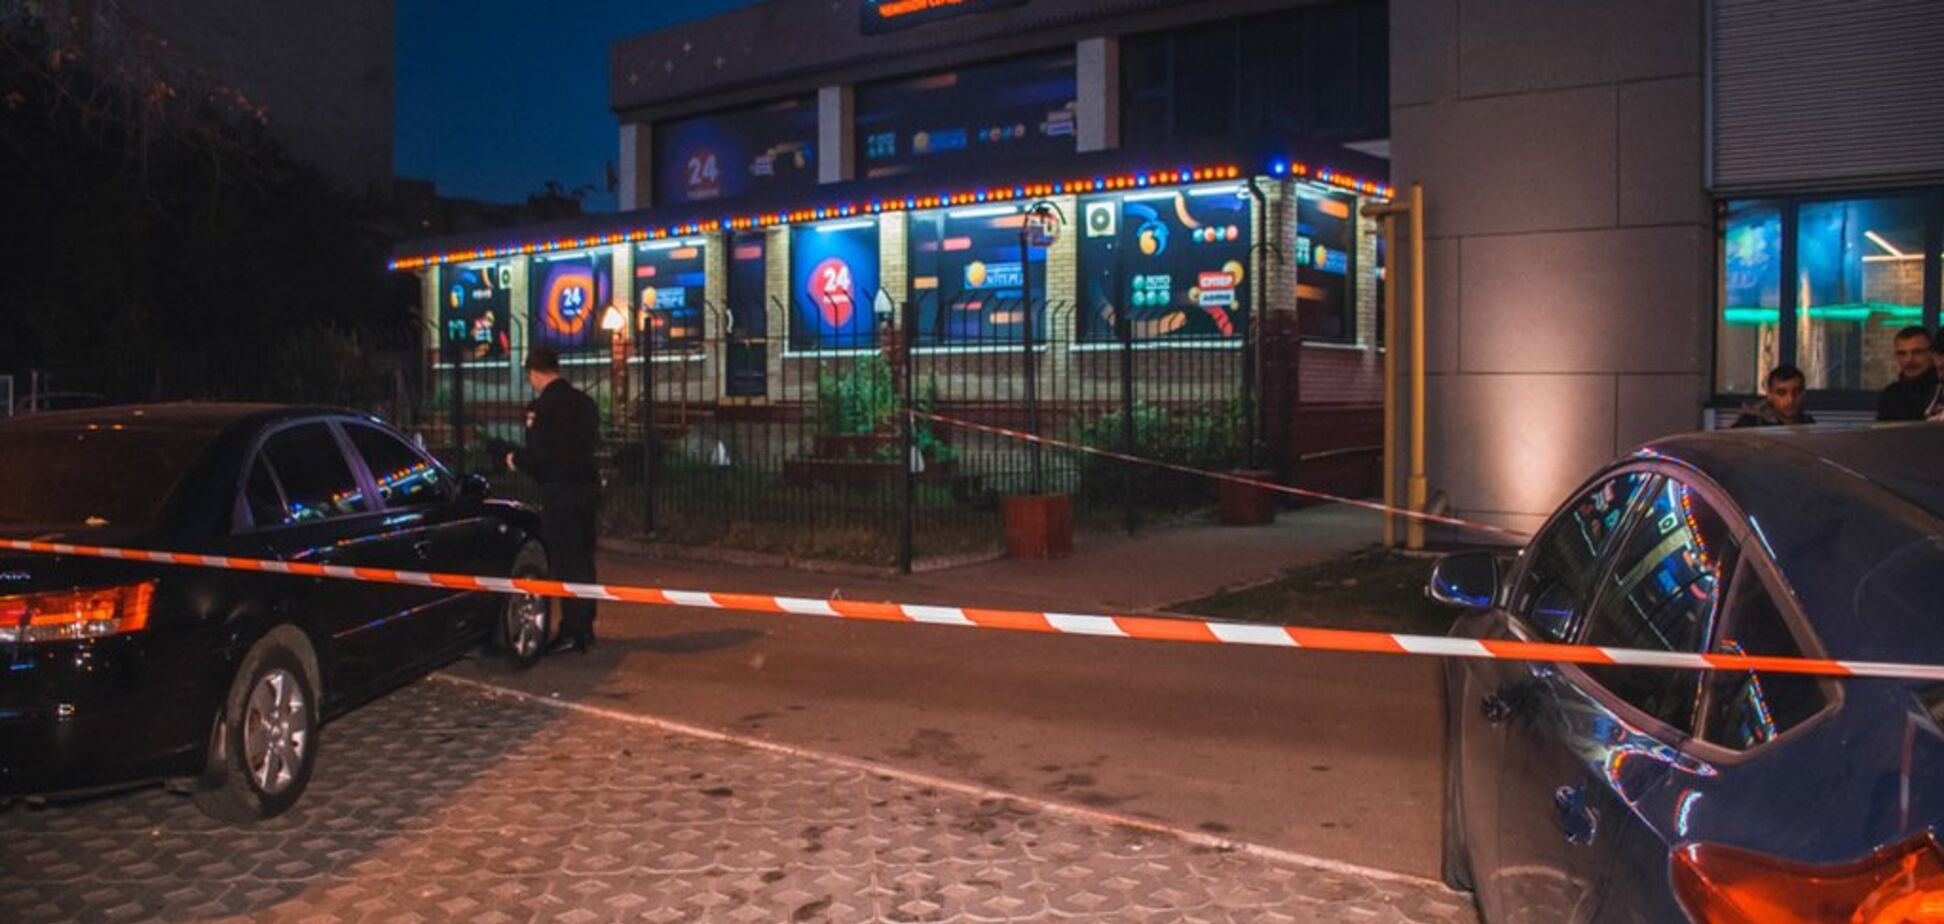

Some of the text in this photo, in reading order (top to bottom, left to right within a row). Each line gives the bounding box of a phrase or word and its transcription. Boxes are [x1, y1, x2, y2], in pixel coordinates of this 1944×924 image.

[688, 154, 718, 185] 24
[824, 265, 851, 291] 24
[563, 286, 581, 306] 24
